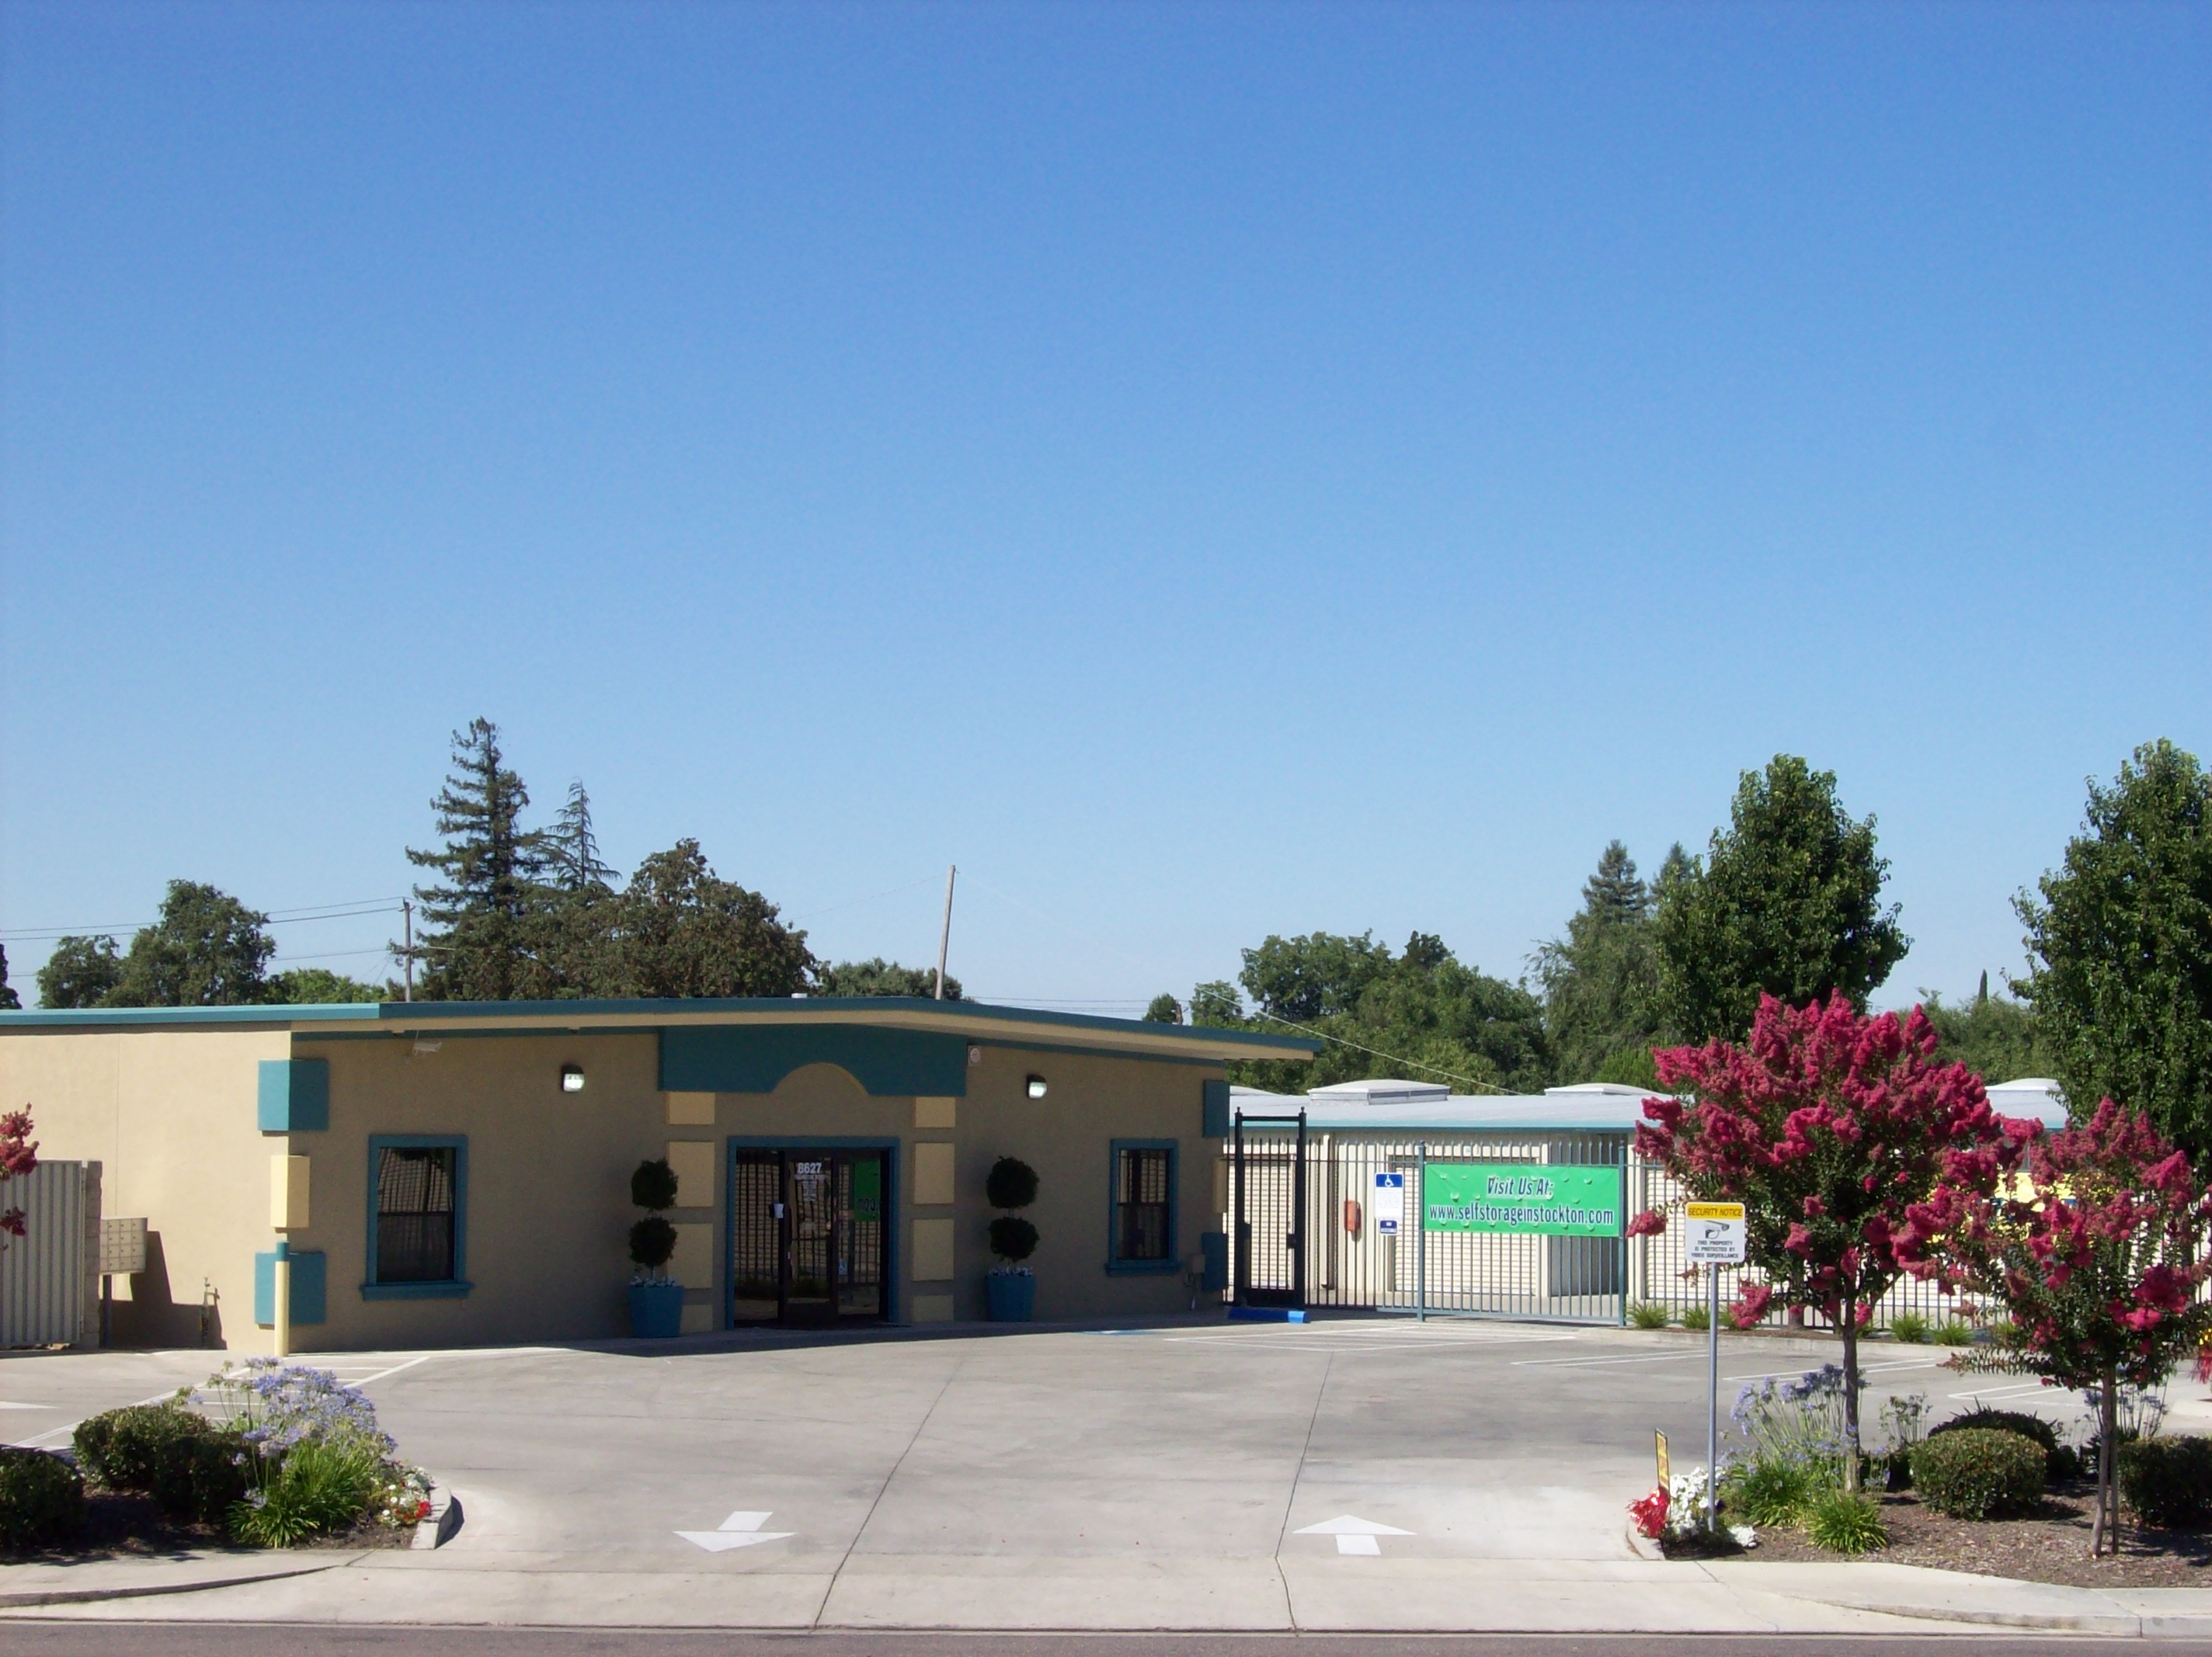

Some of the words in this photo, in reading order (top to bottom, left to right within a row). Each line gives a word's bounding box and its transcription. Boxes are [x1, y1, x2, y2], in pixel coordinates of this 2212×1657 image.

[798, 1162, 823, 1174] 8627
[1487, 1176, 1514, 1195] Visit
[1518, 1176, 1532, 1196] Us
[1536, 1177, 1554, 1197] At:
[1429, 1202, 1613, 1226] www.selfstorageinstockton.com
[1688, 1207, 1717, 1216] SECURITY
